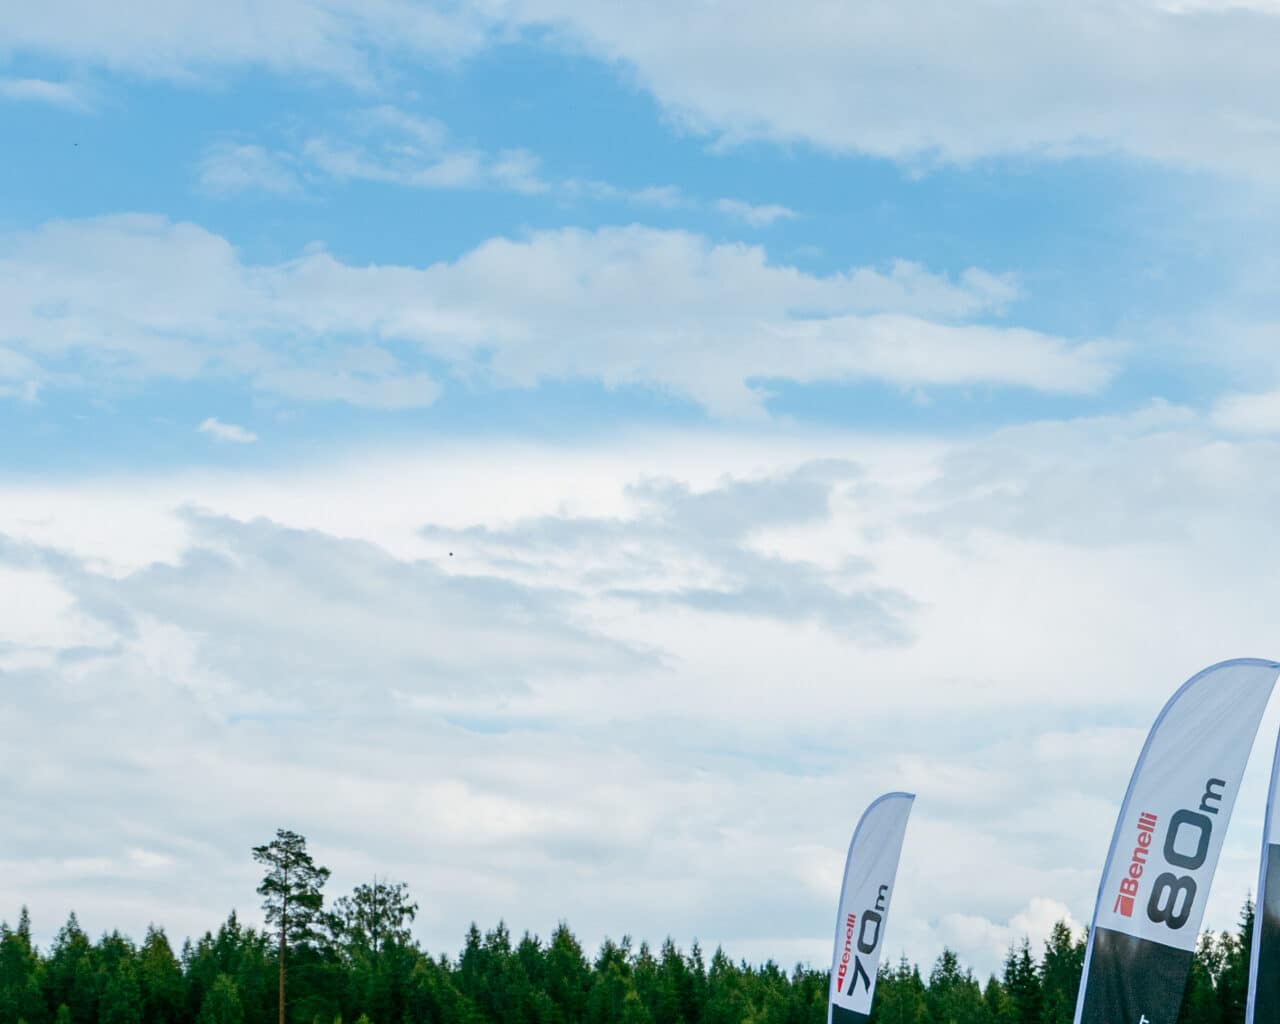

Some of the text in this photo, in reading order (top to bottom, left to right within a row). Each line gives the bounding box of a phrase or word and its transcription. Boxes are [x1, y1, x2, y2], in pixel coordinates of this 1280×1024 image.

[1119, 812, 1158, 897] Benelli
[1147, 778, 1226, 930] 80m
[838, 913, 856, 978] Benelli
[847, 884, 888, 997] 70m
